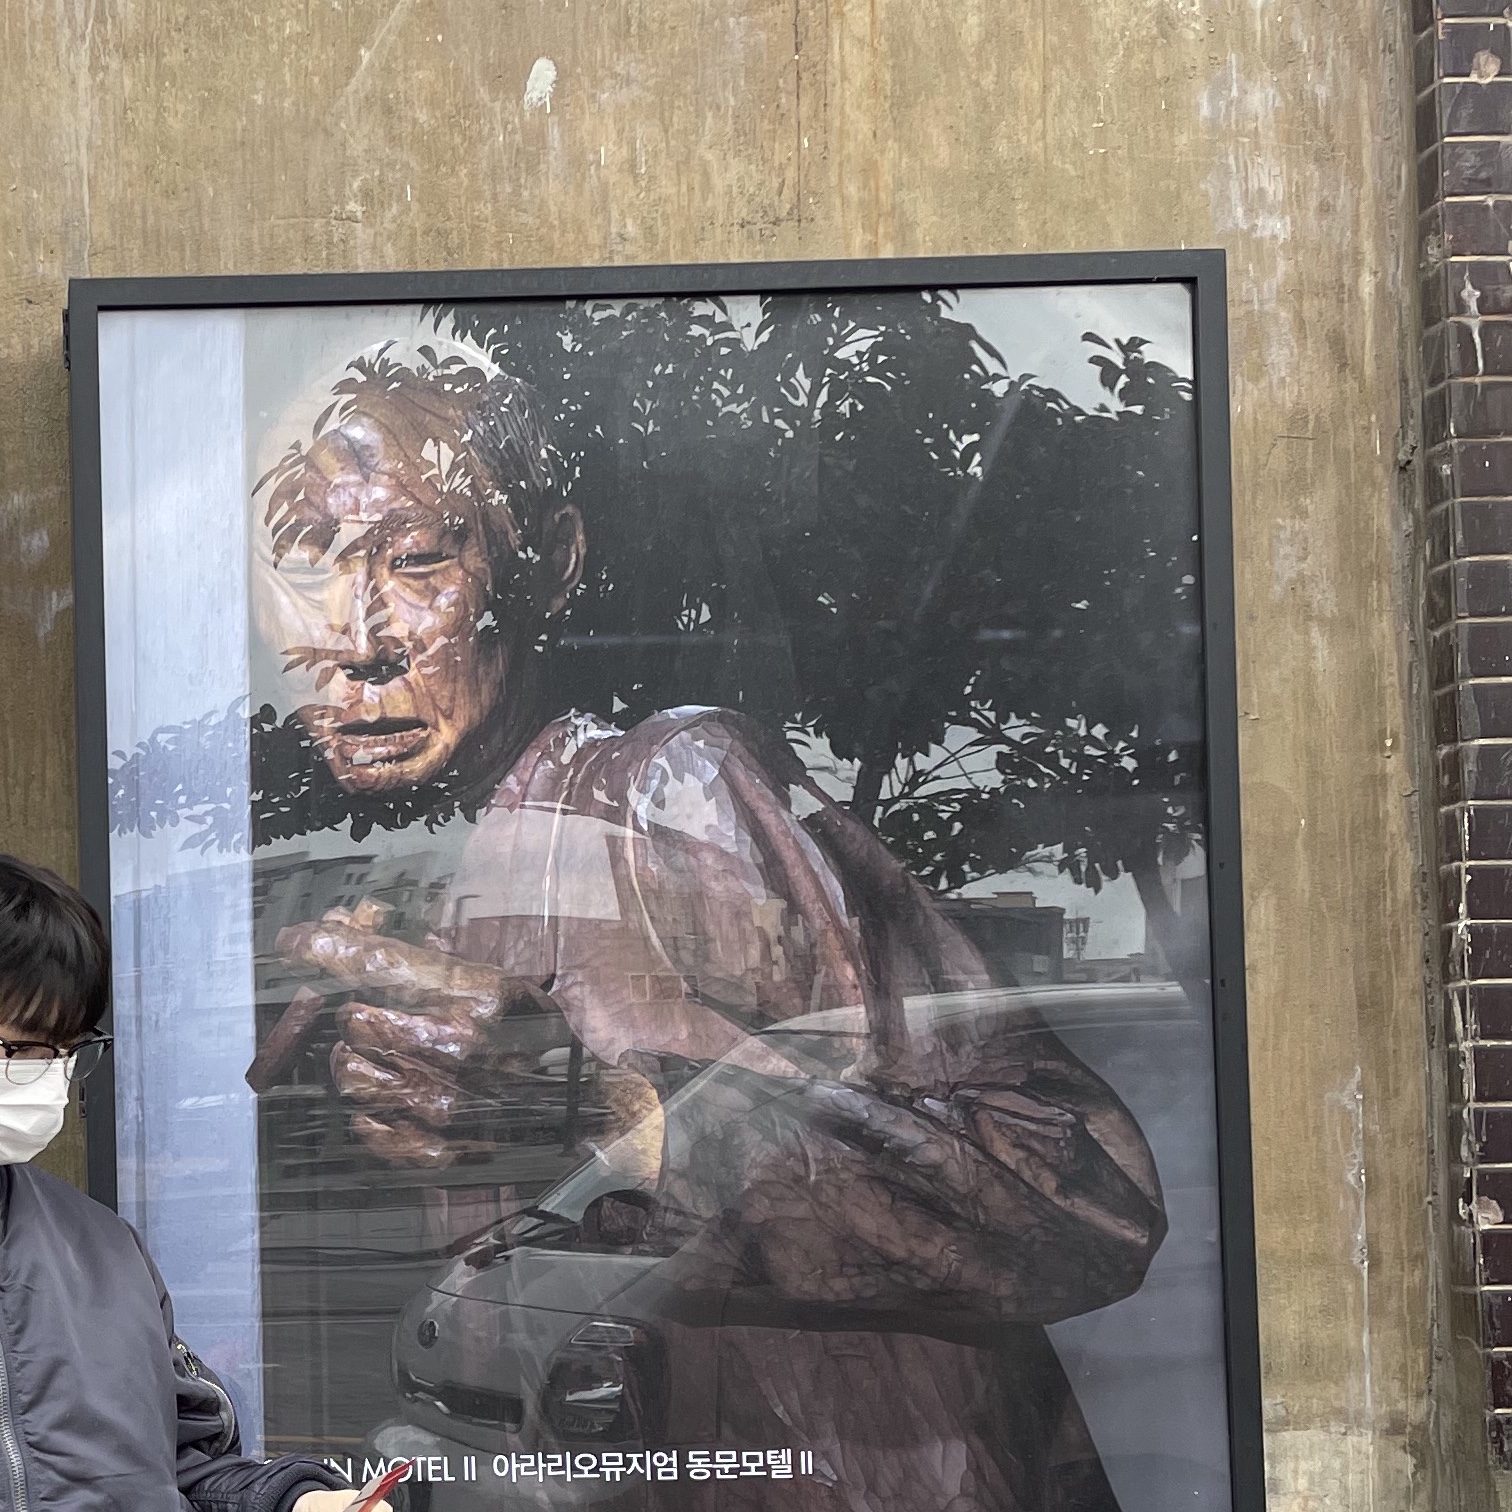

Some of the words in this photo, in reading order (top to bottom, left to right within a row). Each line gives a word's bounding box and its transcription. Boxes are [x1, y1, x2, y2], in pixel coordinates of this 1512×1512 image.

[361, 1456, 455, 1483] MOTEL
[492, 1450, 679, 1483] 아라리오뮤지엄
[686, 1449, 794, 1481] 동문모텔
